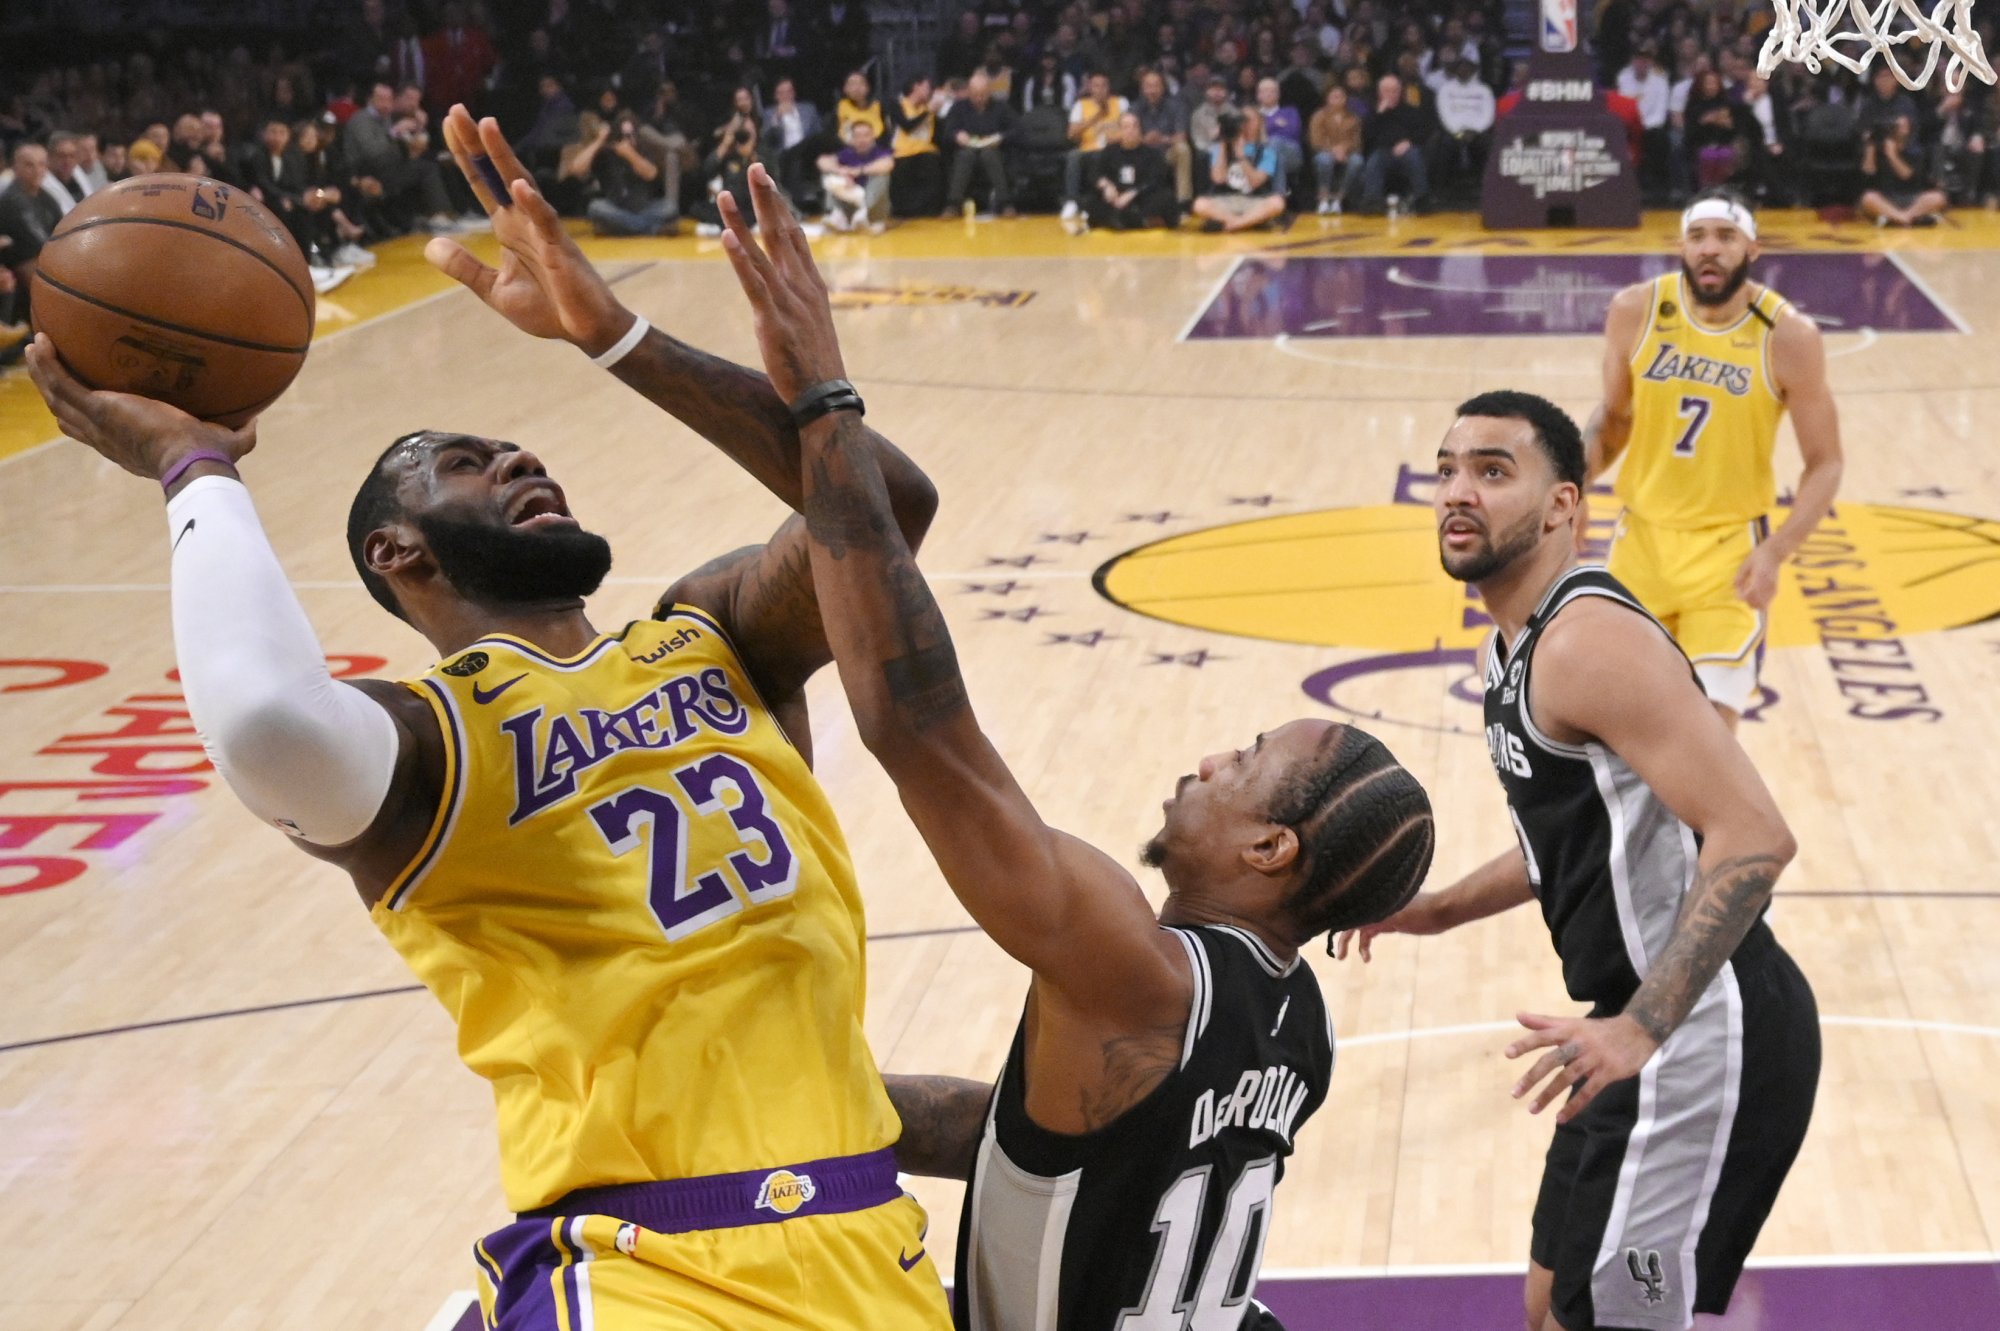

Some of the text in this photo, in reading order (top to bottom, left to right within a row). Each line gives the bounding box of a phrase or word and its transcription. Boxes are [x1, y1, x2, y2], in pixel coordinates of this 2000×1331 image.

[1526, 79, 1592, 101] #BHM
[1641, 342, 1752, 397] LAKERS
[1673, 395, 1712, 458] 7
[630, 627, 701, 665] wish
[501, 666, 749, 828] LAKERS
[585, 752, 799, 943] 23
[754, 1181, 816, 1209] LAKERS
[1111, 1153, 1278, 1331] 10
